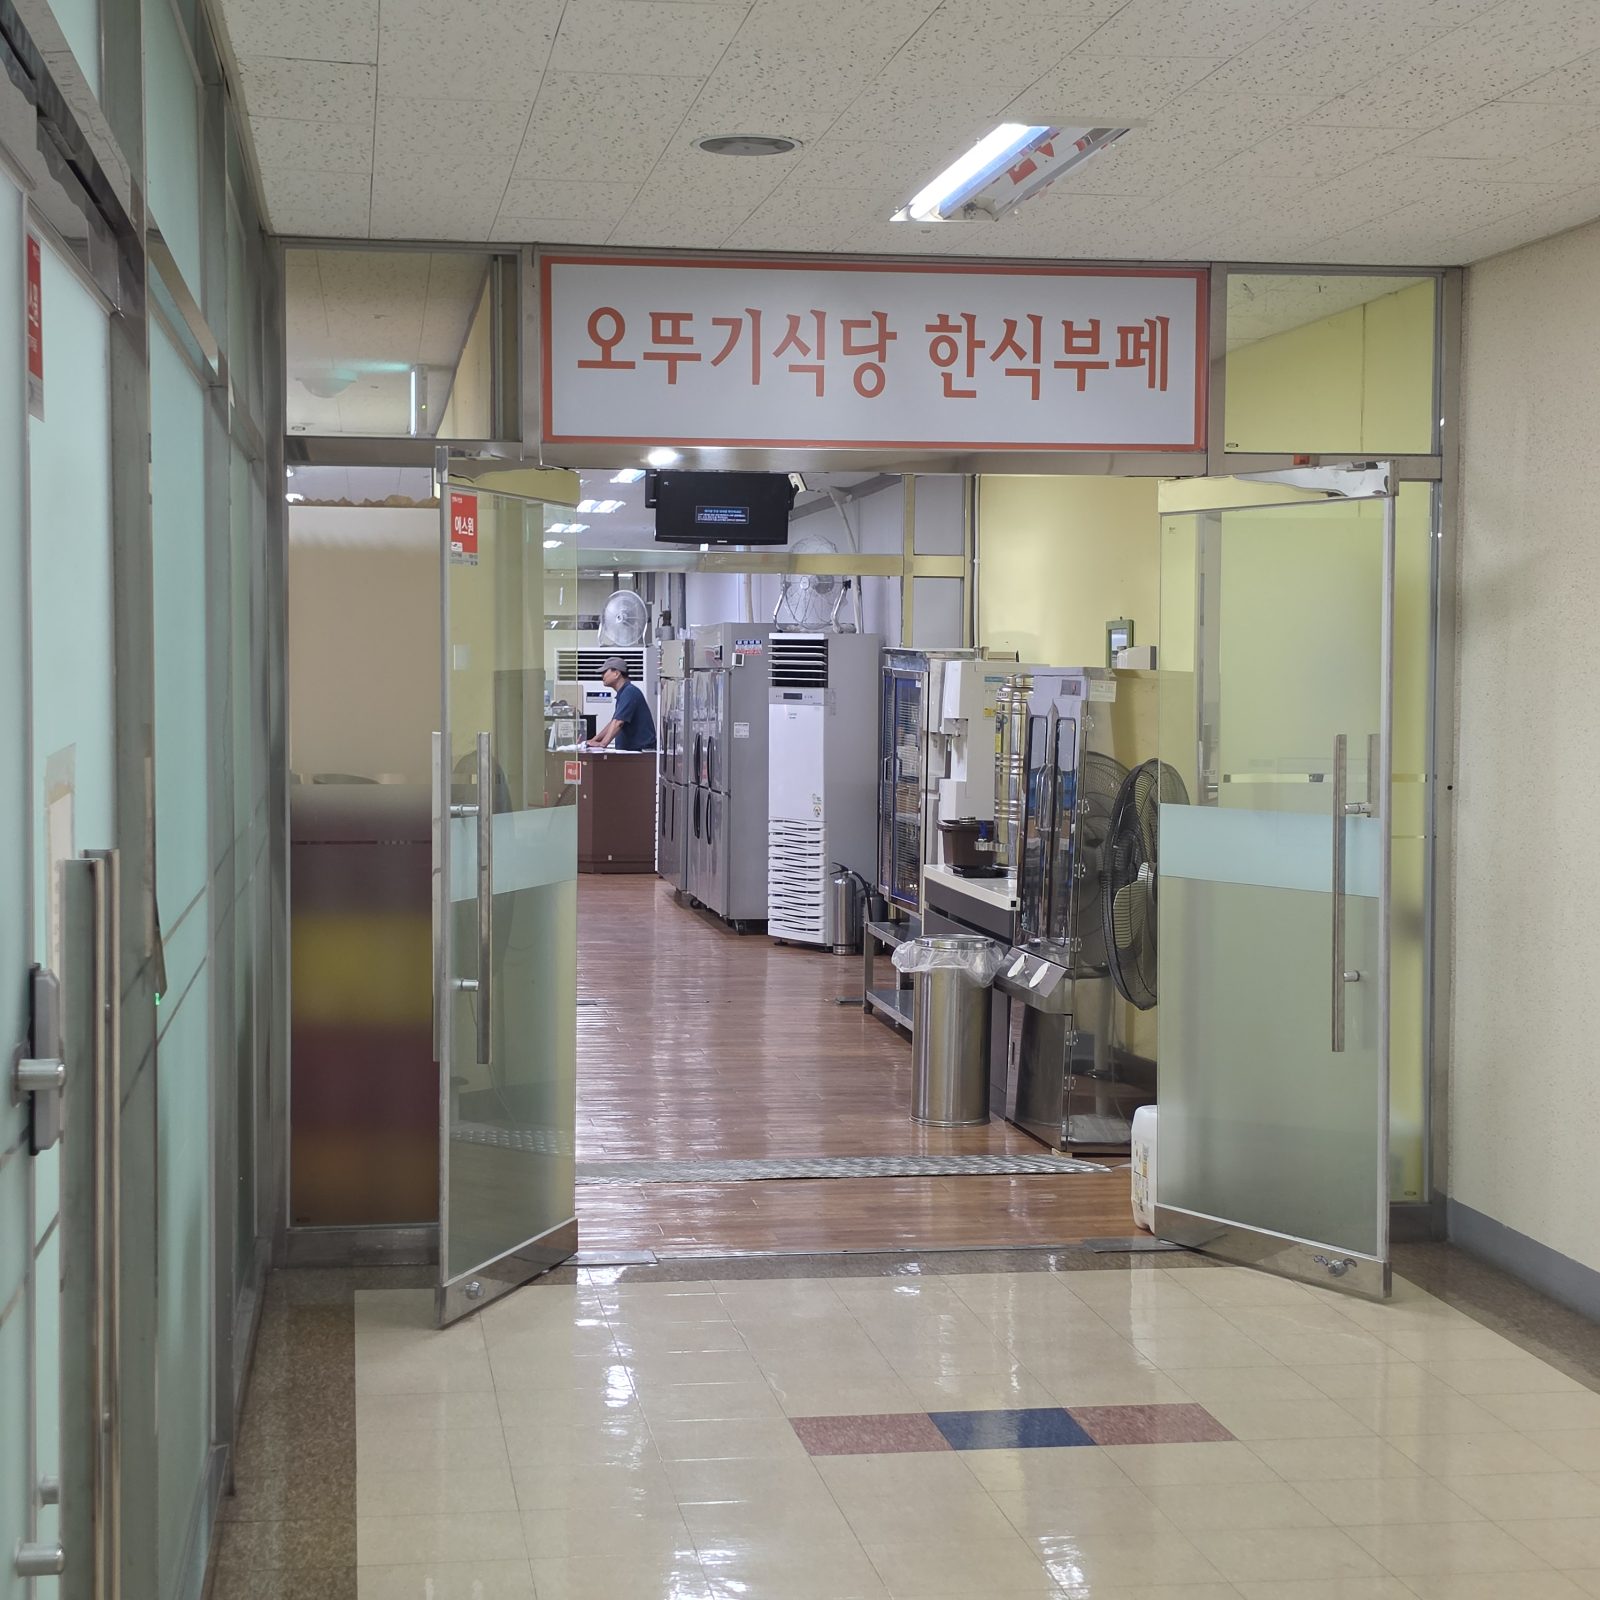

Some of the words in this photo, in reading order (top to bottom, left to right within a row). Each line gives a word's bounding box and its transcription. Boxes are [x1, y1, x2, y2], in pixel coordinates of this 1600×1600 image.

[578, 306, 897, 398] 오뚜기식당
[925, 312, 1170, 400] 한식부페
[454, 516, 474, 535] 에스원
